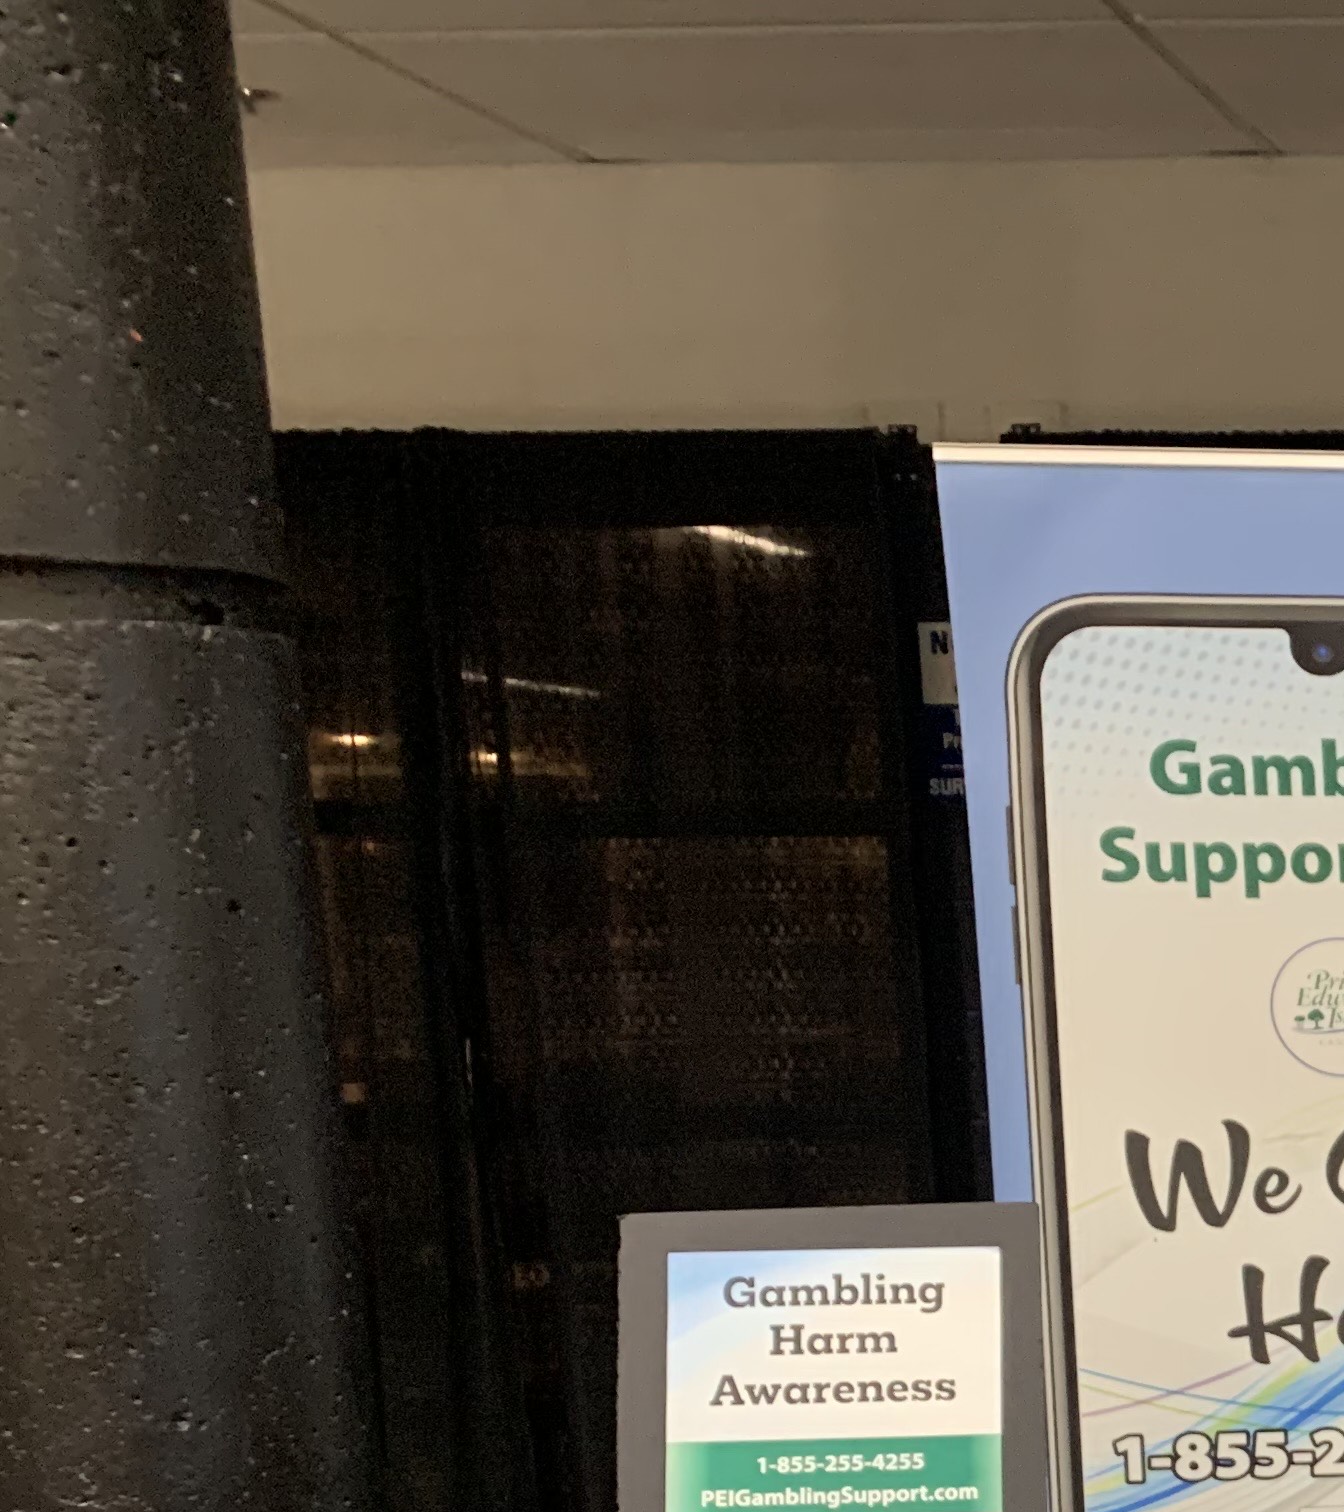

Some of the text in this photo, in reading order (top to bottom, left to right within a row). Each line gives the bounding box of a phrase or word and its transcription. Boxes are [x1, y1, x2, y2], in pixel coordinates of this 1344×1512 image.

[1124, 1118, 1302, 1232] We
[723, 1273, 945, 1313] Gambling
[769, 1323, 898, 1356] Harm
[709, 1373, 957, 1406] Awareness
[757, 1452, 925, 1475] 1-855-255-4255
[701, 1483, 979, 1509] PEIGamblingSupport.com
